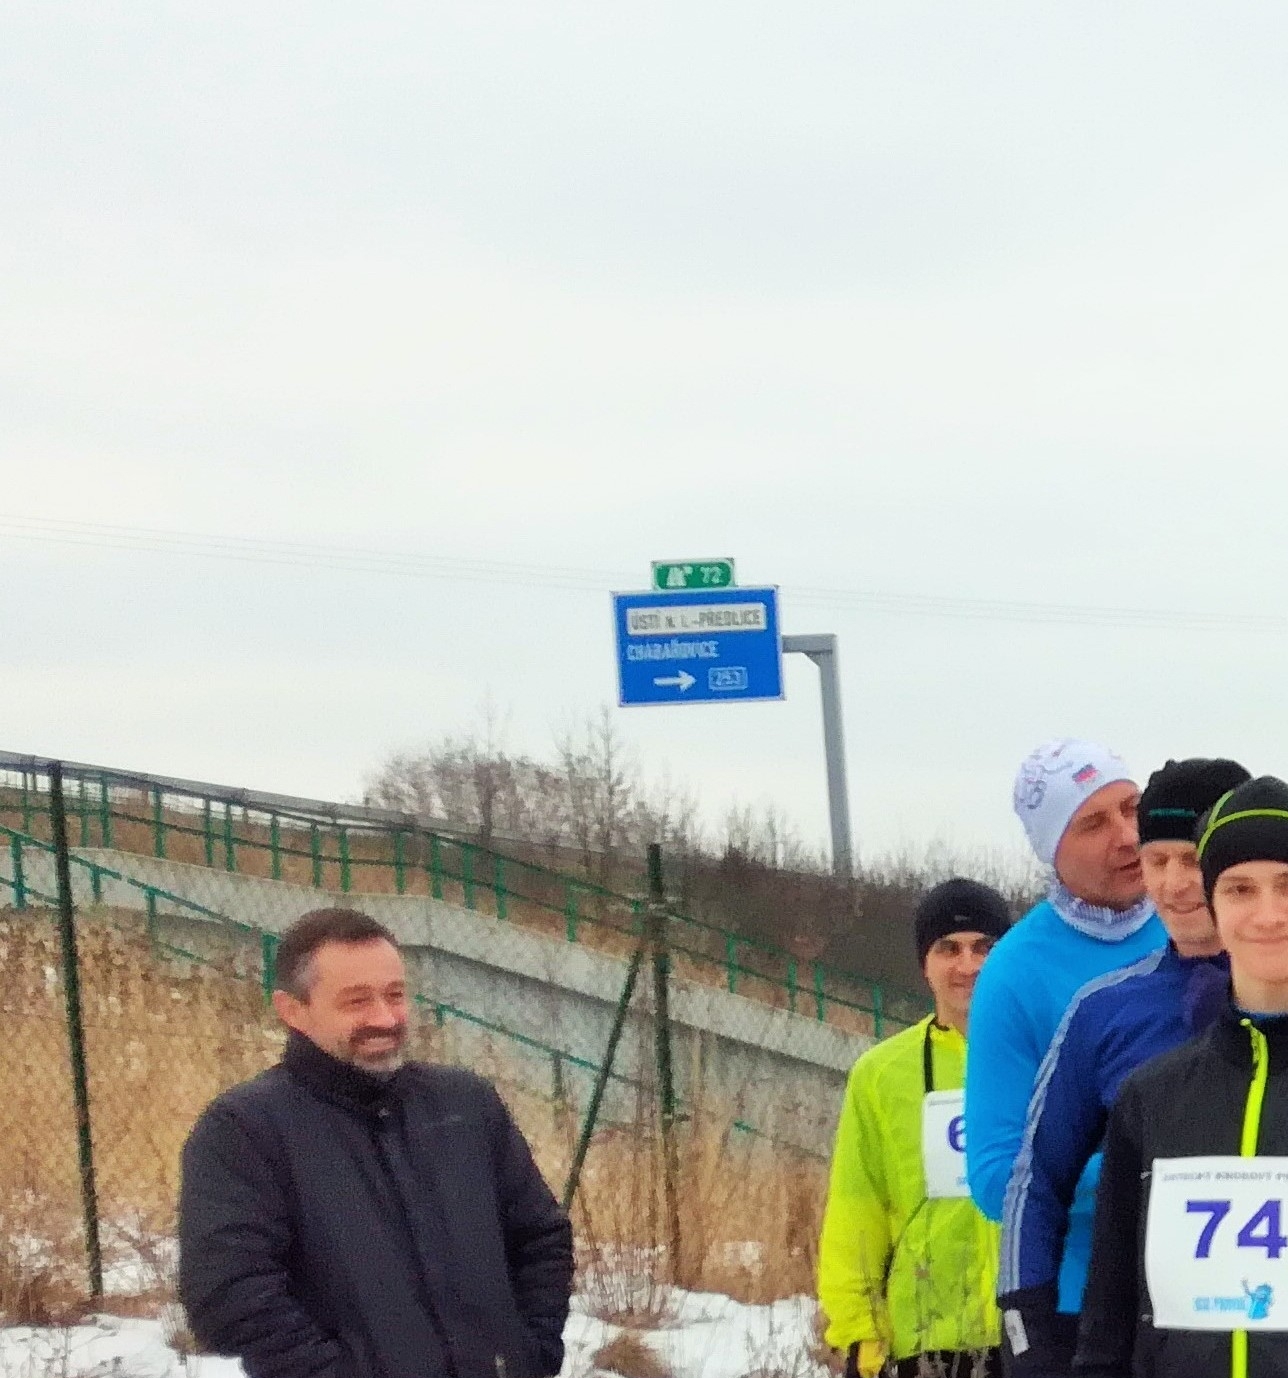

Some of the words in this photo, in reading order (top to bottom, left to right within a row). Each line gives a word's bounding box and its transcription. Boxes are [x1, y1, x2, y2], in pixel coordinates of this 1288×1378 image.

[700, 566, 723, 584] 72
[947, 1115, 967, 1153] 6
[1186, 1200, 1288, 1259] 74
